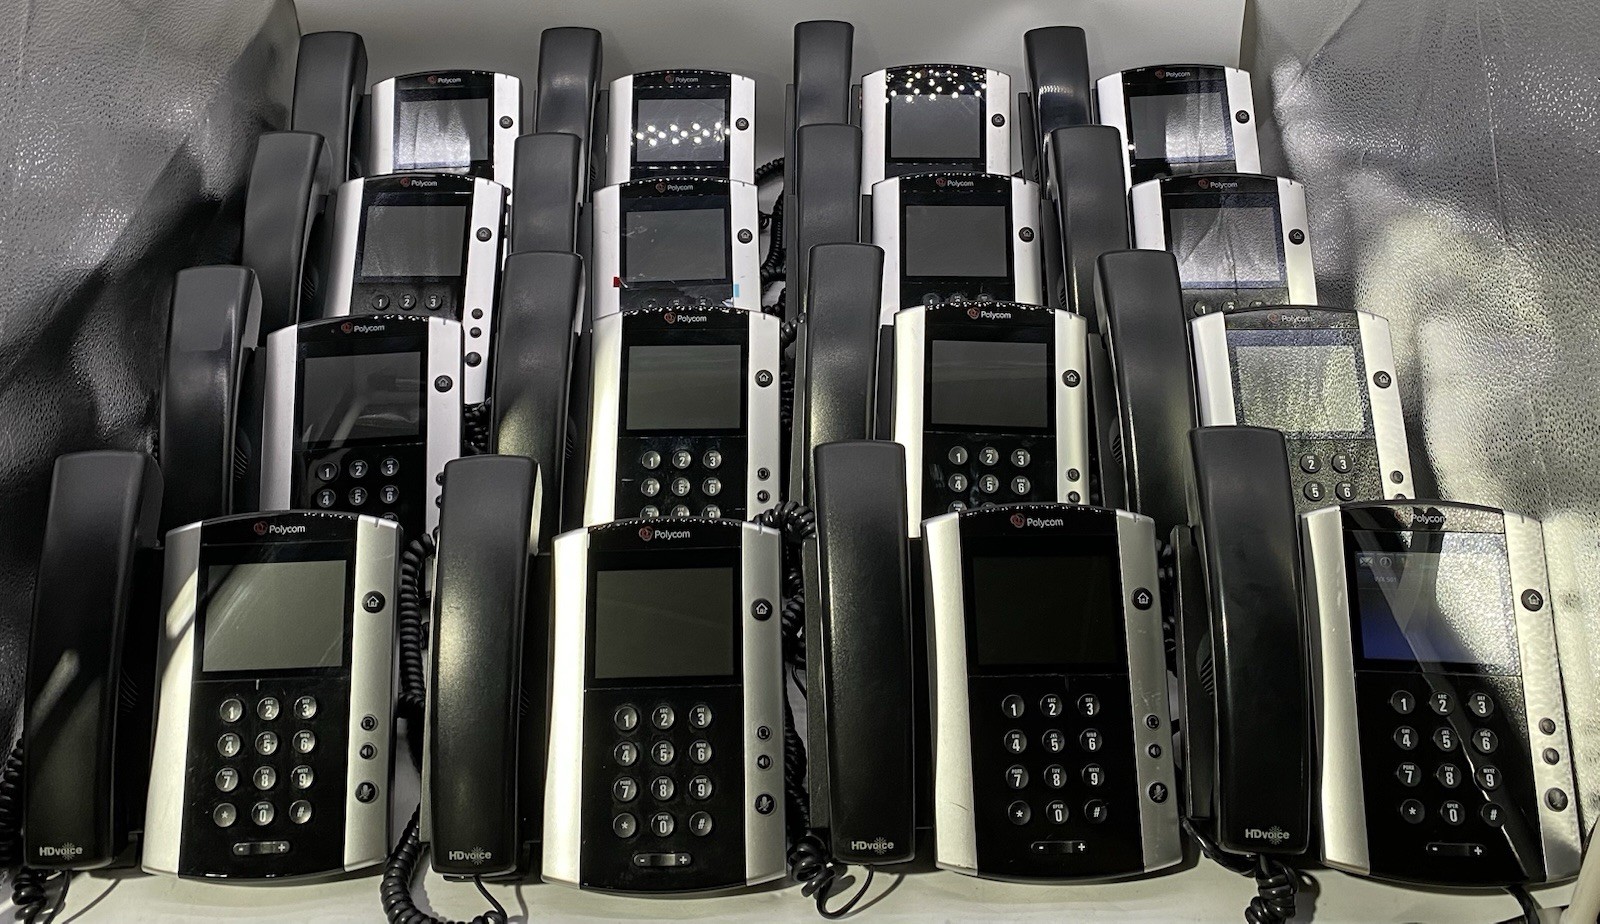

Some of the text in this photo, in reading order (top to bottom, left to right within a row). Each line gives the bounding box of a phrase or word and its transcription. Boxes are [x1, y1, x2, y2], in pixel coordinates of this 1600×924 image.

[411, 179, 437, 187] Polycom
[947, 179, 974, 187] Polycom
[1210, 181, 1237, 189] Polycom
[677, 315, 707, 323] Polycom
[981, 311, 1011, 320] Polycom
[354, 325, 385, 333] Polycom
[1027, 518, 1064, 528] Polycom
[270, 525, 305, 535] Polycom
[654, 530, 690, 540] Polycom
[302, 704, 309, 716] 3
[1011, 703, 1017, 716] 1
[1049, 703, 1056, 716] 2
[1086, 702, 1094, 716] 3
[1401, 698, 1407, 711] 1
[1439, 699, 1447, 712] 2
[1478, 701, 1486, 714] 3
[229, 707, 234, 719] 1
[265, 705, 272, 717] 2
[623, 714, 629, 727] 1
[660, 713, 667, 726] 2
[697, 713, 705, 725] 3
[263, 740, 270, 752] 5
[300, 738, 308, 750] 6
[1012, 739, 1020, 751] 4
[1051, 738, 1059, 751] 5
[1088, 738, 1096, 750] 6
[1402, 734, 1411, 747] 4
[1442, 735, 1451, 748] 5
[1482, 737, 1490, 750] 6
[225, 741, 233, 753] 4
[621, 750, 630, 762] 4
[660, 749, 667, 761] 5
[697, 748, 705, 761] 6
[224, 776, 230, 788] 7
[261, 774, 268, 786] 8
[299, 773, 306, 785] 9
[1013, 774, 1021, 787] 7
[1053, 773, 1060, 786] 8
[1091, 773, 1098, 785] 9
[1405, 770, 1412, 783] 7
[1445, 772, 1454, 785] 8
[1486, 774, 1494, 787] 9
[622, 785, 629, 798] 7
[659, 784, 667, 797] 8
[697, 783, 705, 796] 9
[260, 810, 267, 822] 0
[1055, 809, 1062, 822] 0
[1449, 809, 1458, 822] 0
[659, 820, 667, 833] 0
